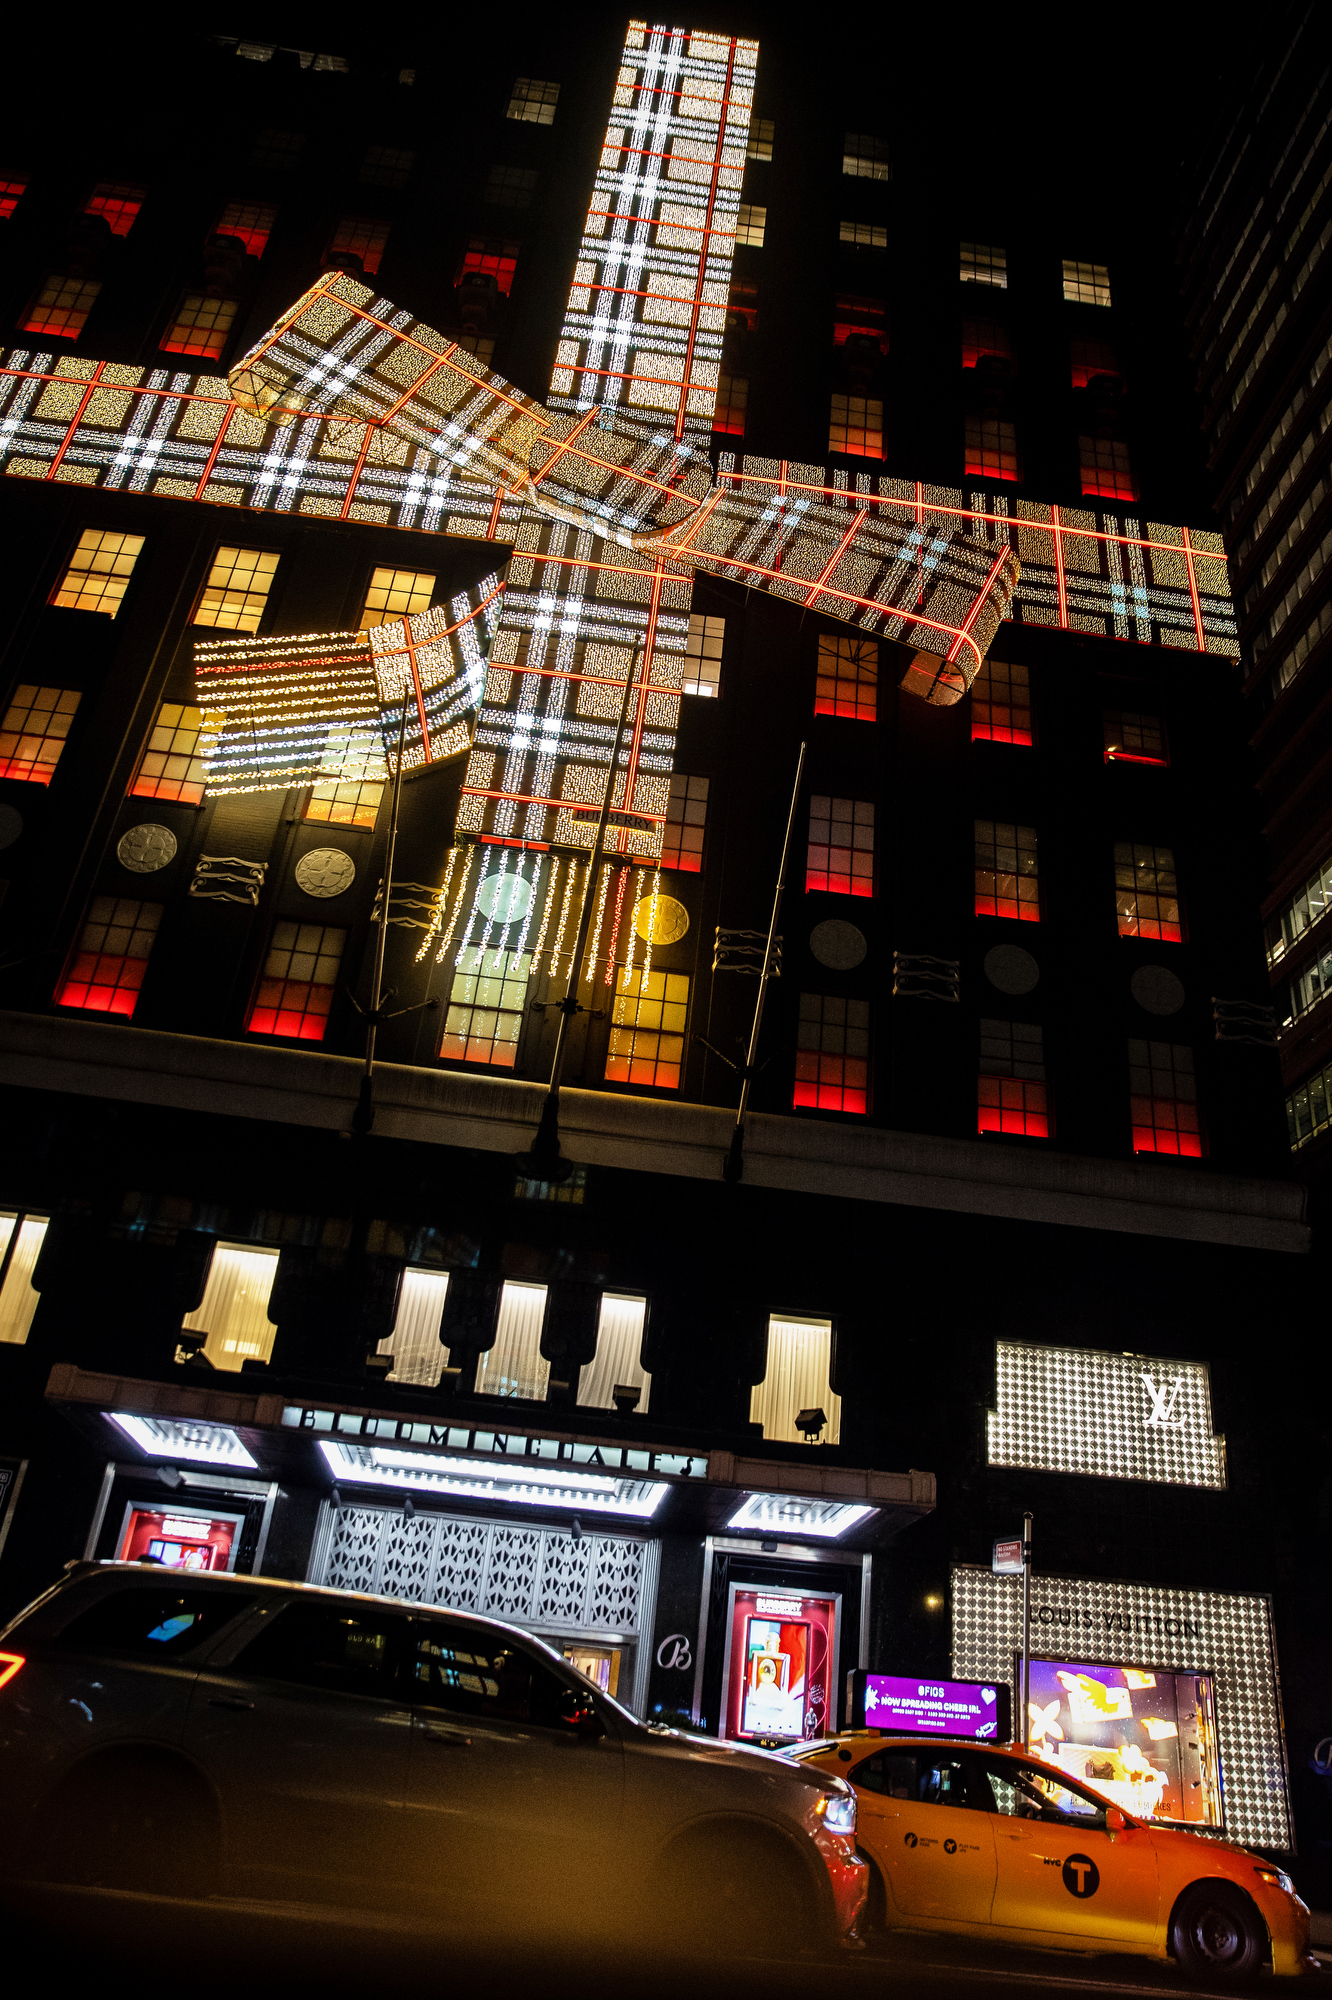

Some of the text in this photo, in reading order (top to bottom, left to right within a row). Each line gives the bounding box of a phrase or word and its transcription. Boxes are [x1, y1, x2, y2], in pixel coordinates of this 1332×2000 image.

[299, 1409, 697, 1476] BLOOMINGDALE'S
[1030, 1604, 1200, 1639] LOUIS VUITTON
[657, 1633, 692, 1671] B
[881, 1697, 900, 1706] NOW
[902, 1698, 943, 1711] SPREADING
[943, 1703, 968, 1712] CHEER
[1043, 1857, 1062, 1867] NYC
[1070, 1861, 1092, 1893] T
